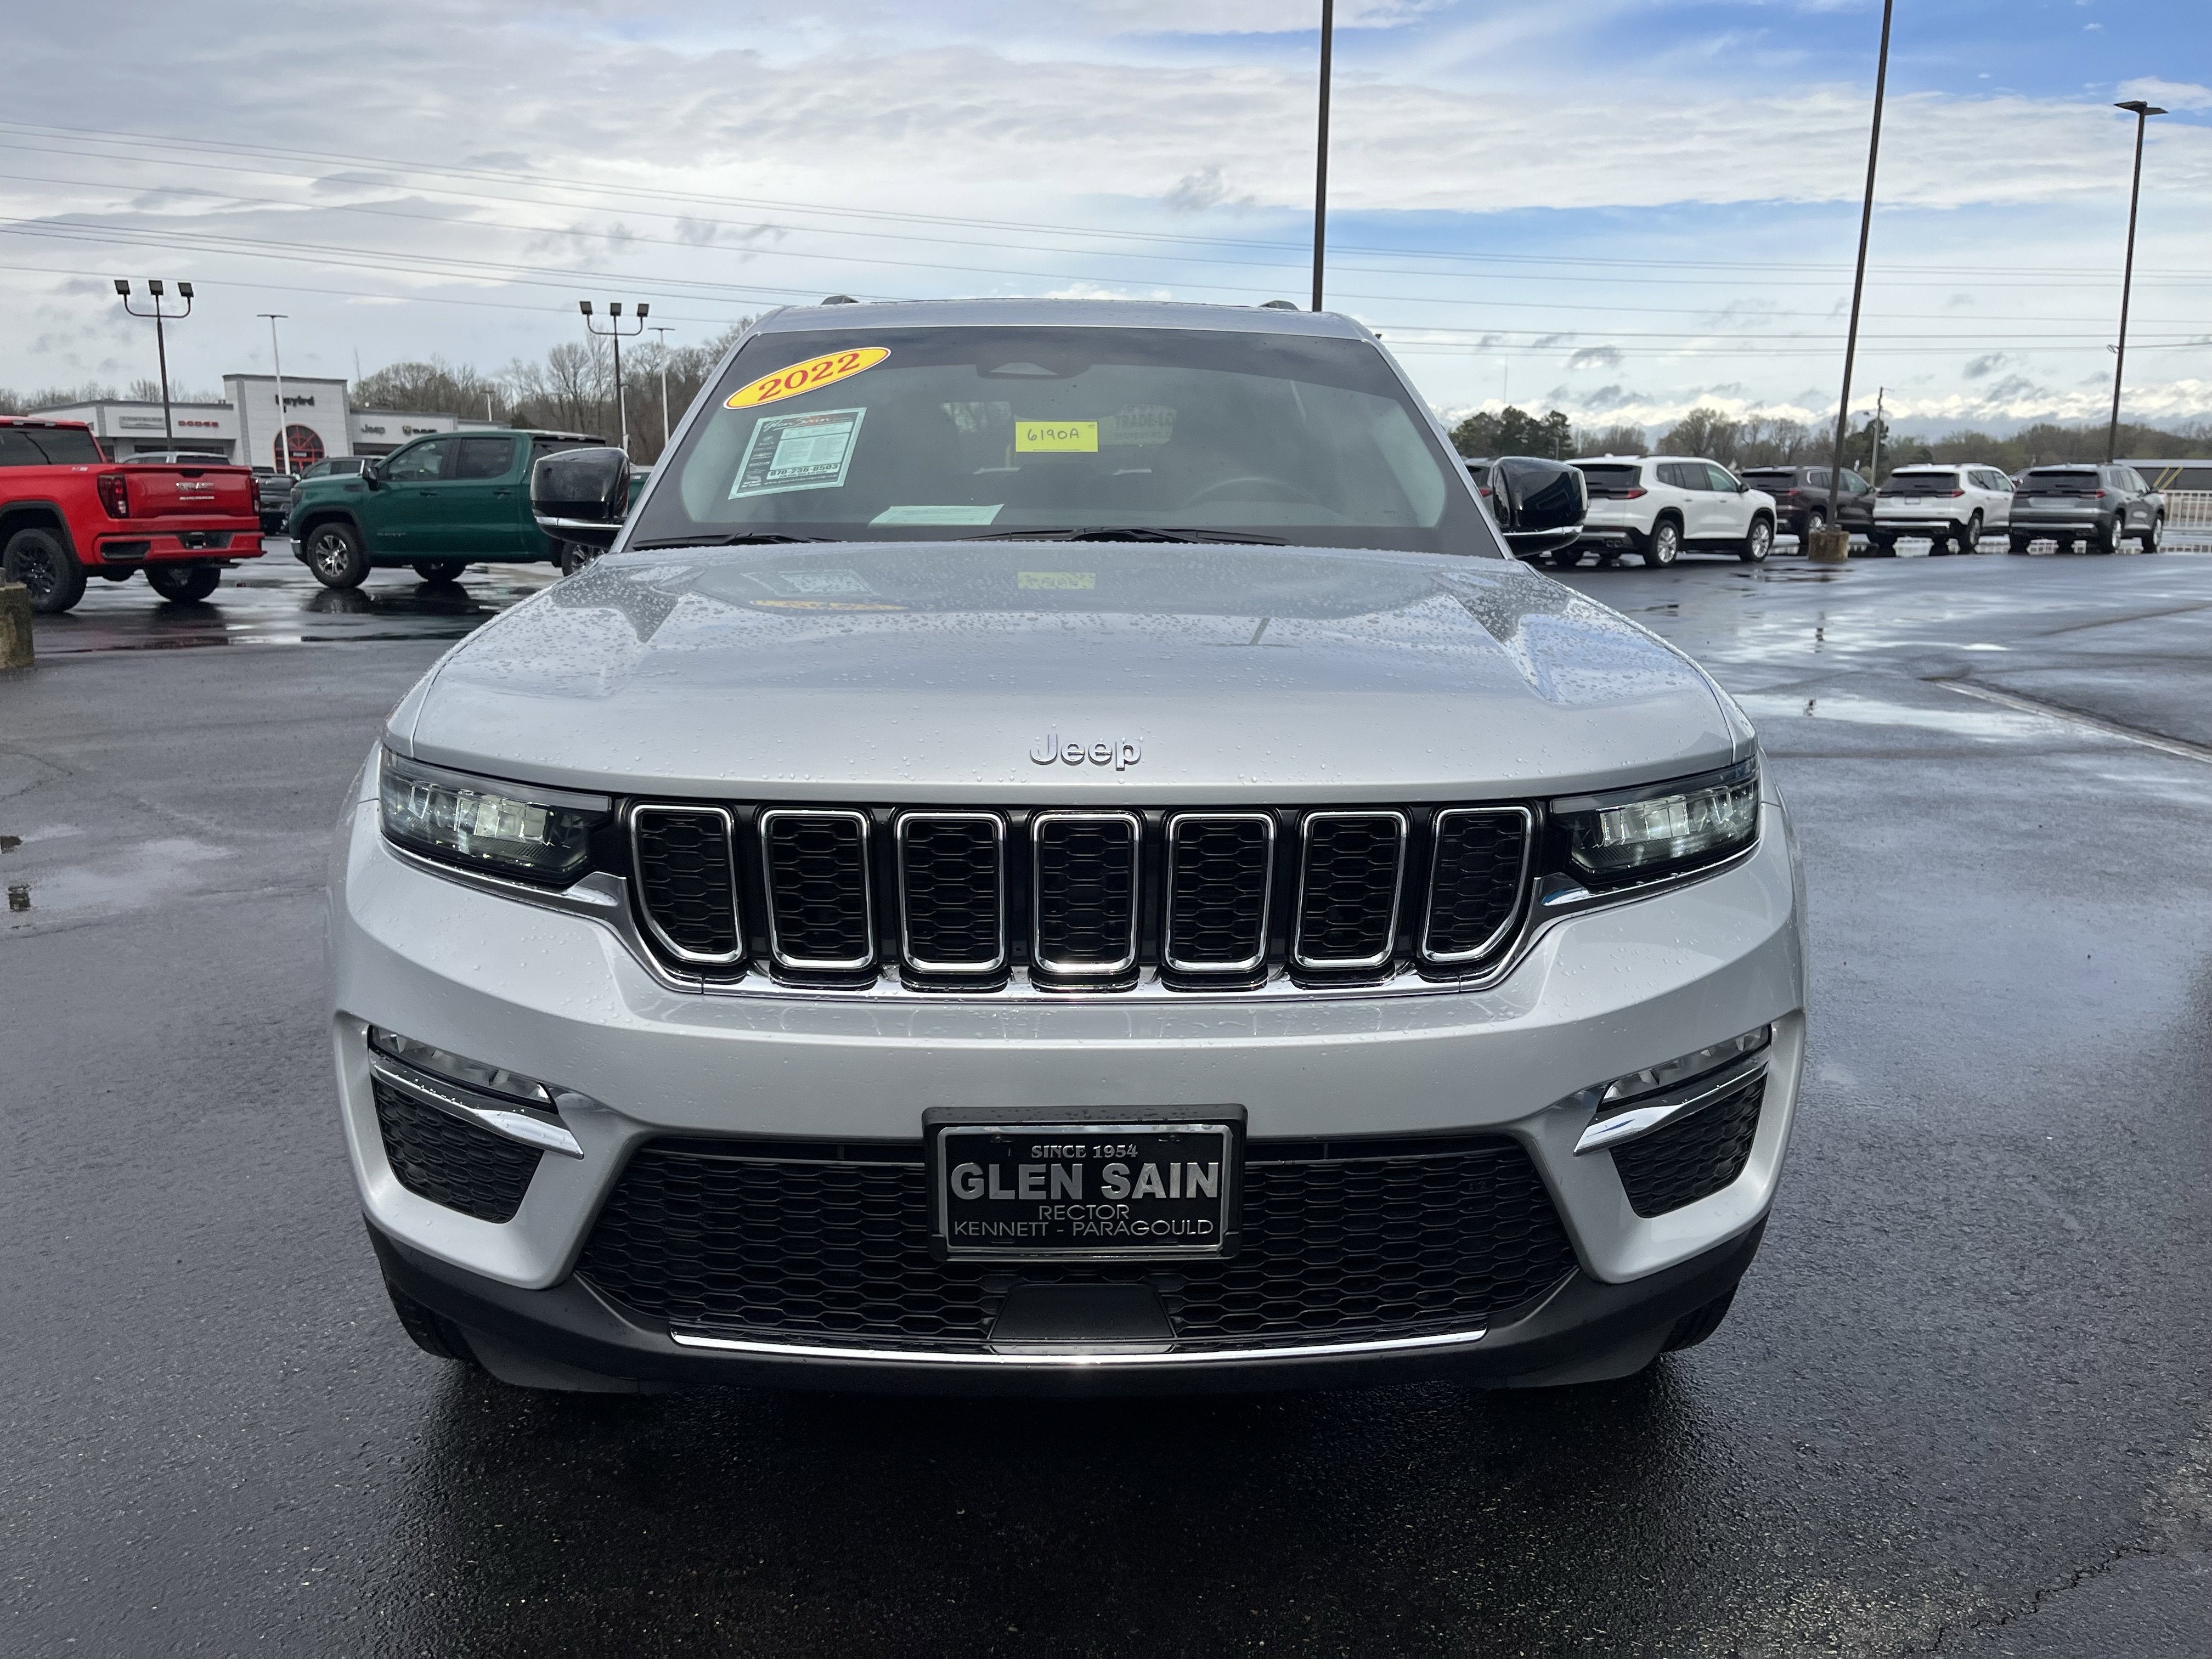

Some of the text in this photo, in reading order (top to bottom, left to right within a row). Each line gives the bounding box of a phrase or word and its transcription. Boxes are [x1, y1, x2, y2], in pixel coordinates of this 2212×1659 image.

[758, 353, 860, 402] 2022
[1028, 428, 1080, 441] 6190A
[1030, 733, 1142, 771] Jeep
[1031, 1144, 1138, 1158] SINCE 1954
[951, 1162, 1219, 1200] GLEN SAIN
[1039, 1205, 1130, 1220] RECTOR
[955, 1221, 1049, 1237] KENNETT
[1073, 1220, 1214, 1237] PARAGOULD
